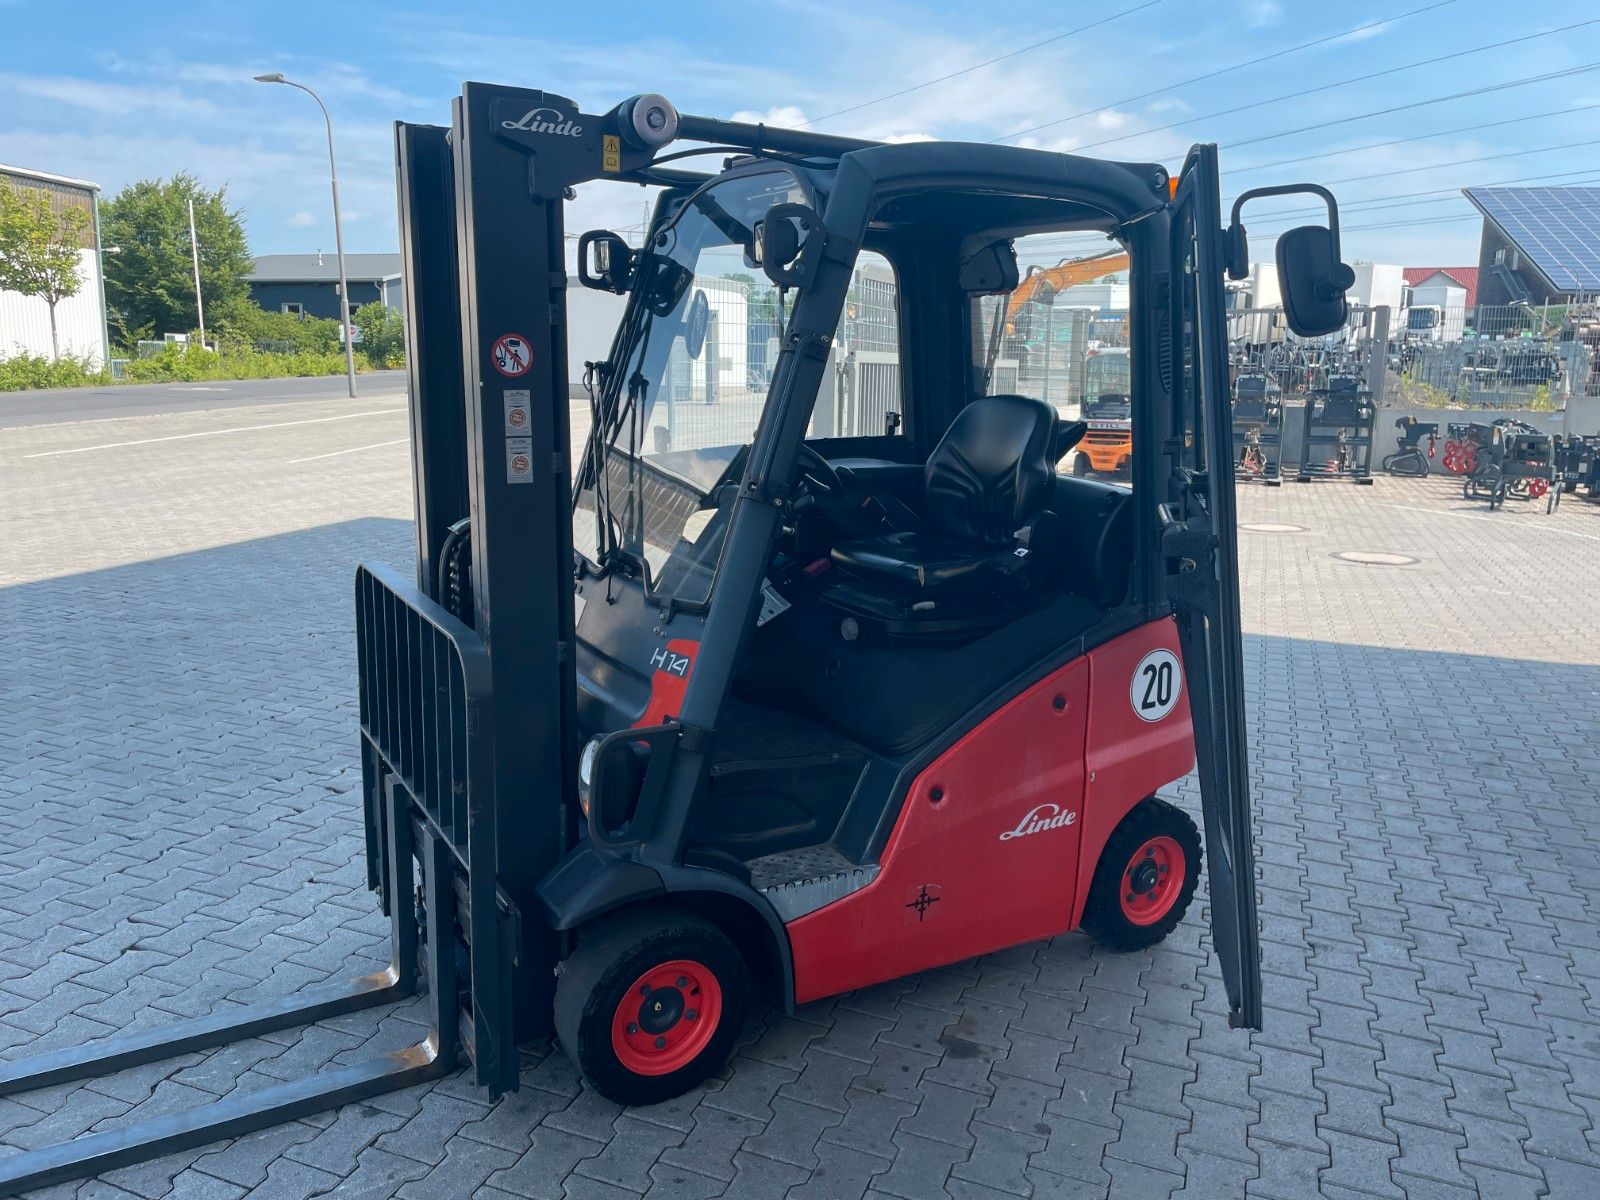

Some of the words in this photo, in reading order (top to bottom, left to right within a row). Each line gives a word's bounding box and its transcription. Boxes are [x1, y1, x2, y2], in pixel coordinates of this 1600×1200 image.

[501, 107, 583, 137] Linde
[649, 647, 689, 677] H14
[1141, 661, 1173, 710] 20
[999, 803, 1077, 841] Linde
